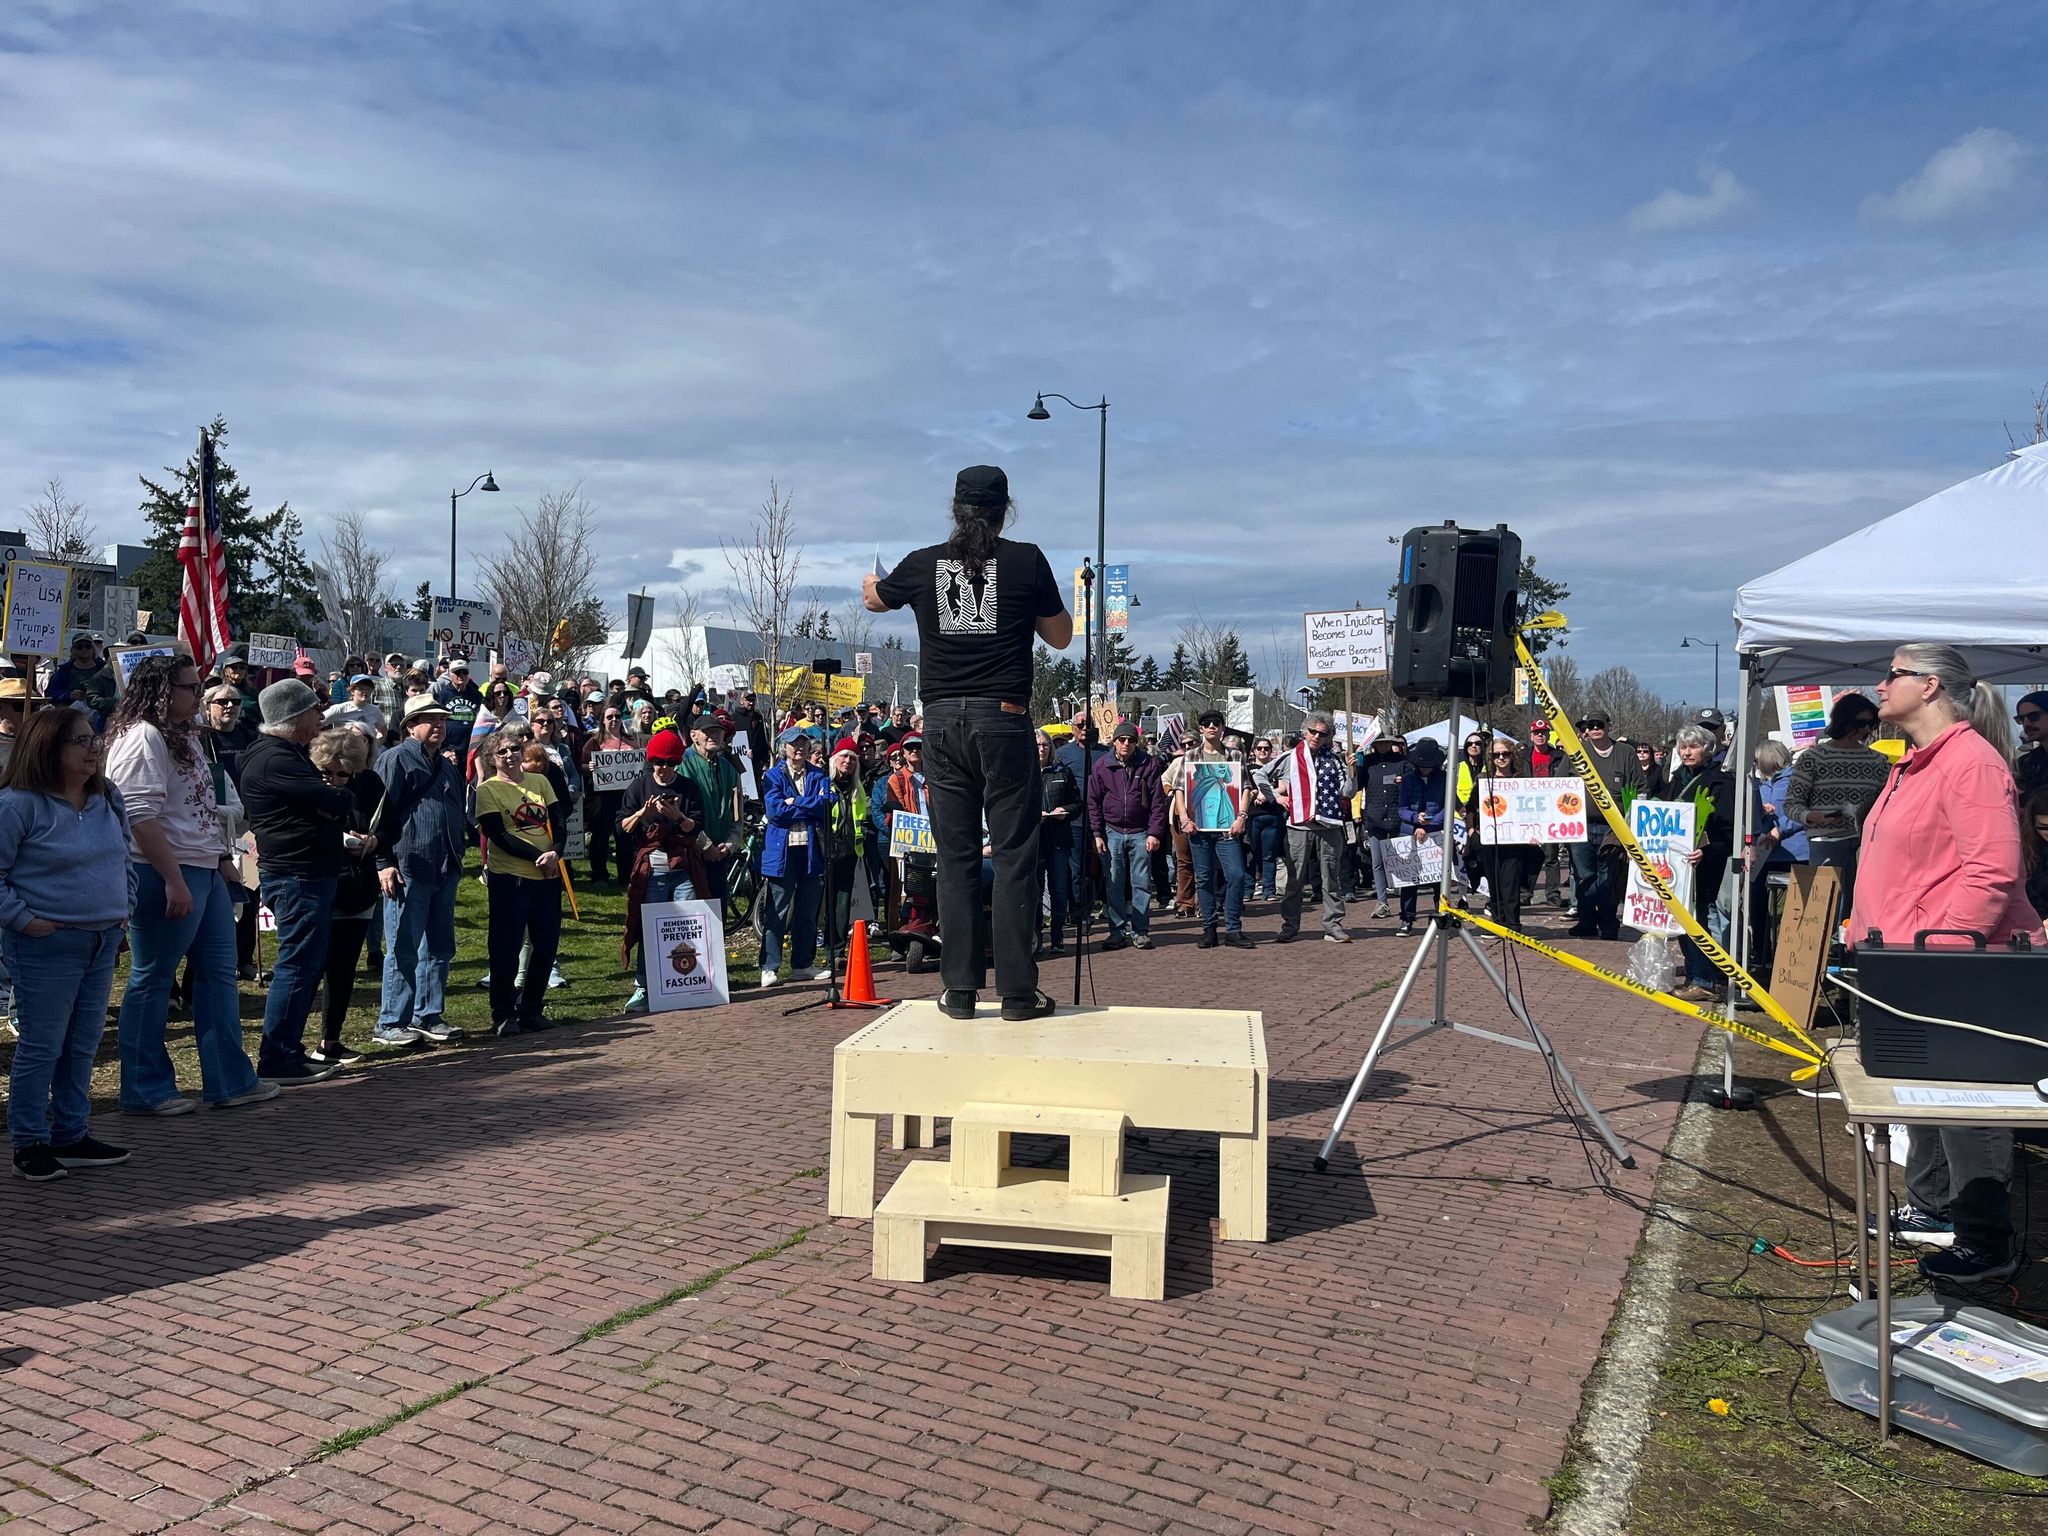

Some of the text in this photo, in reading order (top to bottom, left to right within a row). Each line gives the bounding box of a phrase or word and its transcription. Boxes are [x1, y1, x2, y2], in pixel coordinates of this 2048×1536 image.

[18, 568, 41, 582] Pro
[39, 586, 63, 603] USA
[1076, 585, 1084, 617] Shoreline
[12, 602, 40, 616] Anti-
[435, 596, 484, 610] AMERICANS
[437, 606, 455, 614] BOW
[13, 618, 55, 637] Trump's
[1312, 613, 1384, 629] When Injustice
[19, 634, 43, 649] War
[460, 630, 495, 648] KING
[1311, 628, 1373, 641] Becomes Law
[1308, 644, 1383, 659] Resistance Becomes
[1351, 655, 1375, 669] Duty
[445, 698, 478, 710] SEATTLE
[733, 744, 747, 757] ING
[1484, 779, 1580, 792] DEFEND DEMOCRACY
[1570, 749, 1613, 811] CAUTION
[1516, 796, 1547, 813] ICE
[1562, 794, 1579, 806] NO
[896, 813, 930, 830] FREEZ
[1637, 805, 1686, 837] ROYAL
[895, 828, 914, 845] NO
[1548, 821, 1585, 838] GOOD
[1639, 838, 1669, 854] LUSH
[1411, 861, 1442, 876] SUBJEC
[1625, 843, 1673, 901] CAUTION
[1645, 895, 1672, 915] TUR
[663, 919, 698, 928] REMEMBER
[1633, 907, 1669, 928] REICH
[663, 931, 703, 942] PREVENT
[1692, 934, 1754, 991] CAUTION
[666, 976, 707, 988] FASCISM
